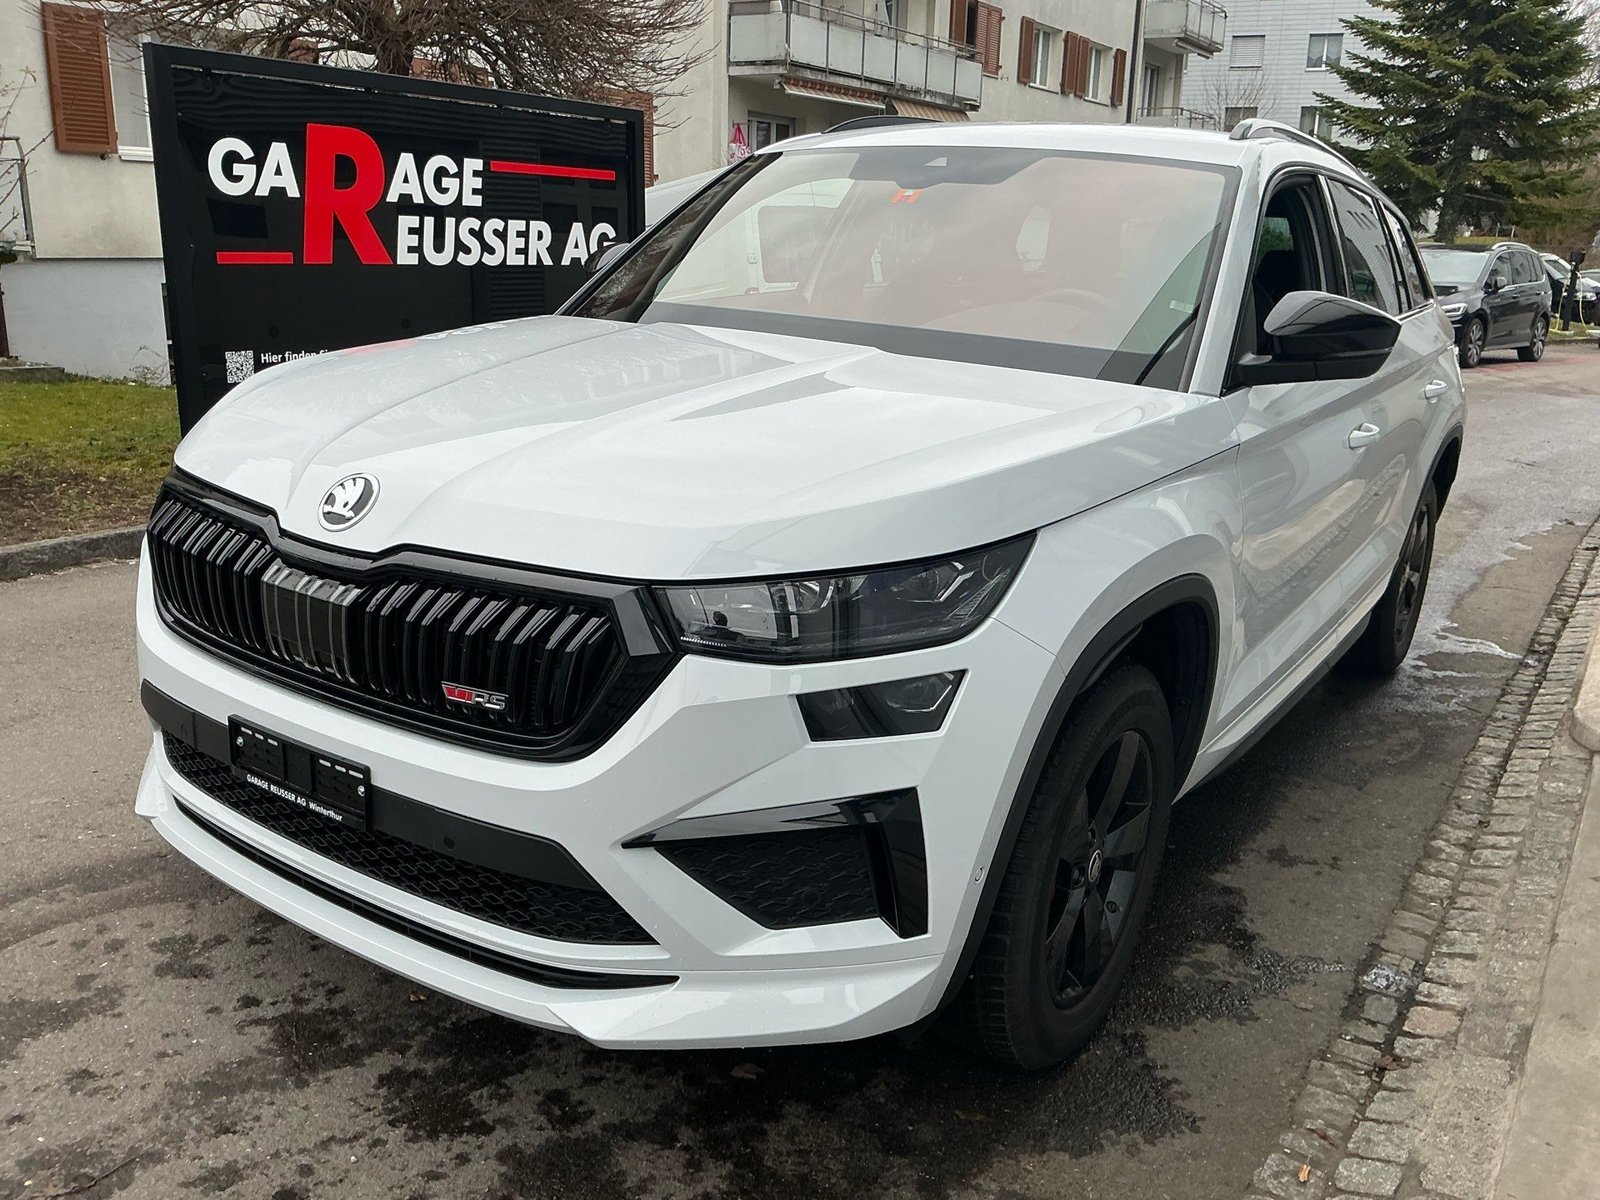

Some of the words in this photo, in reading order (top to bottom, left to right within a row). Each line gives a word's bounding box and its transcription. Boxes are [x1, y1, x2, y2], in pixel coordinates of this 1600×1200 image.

[208, 123, 484, 265] GARAGE
[560, 221, 617, 266] AG
[261, 352, 282, 364] Hier
[246, 773, 269, 790] GARAGE
[270, 784, 296, 802] REUSSER
[297, 796, 307, 807] AG
[308, 801, 343, 822] Winterthur
